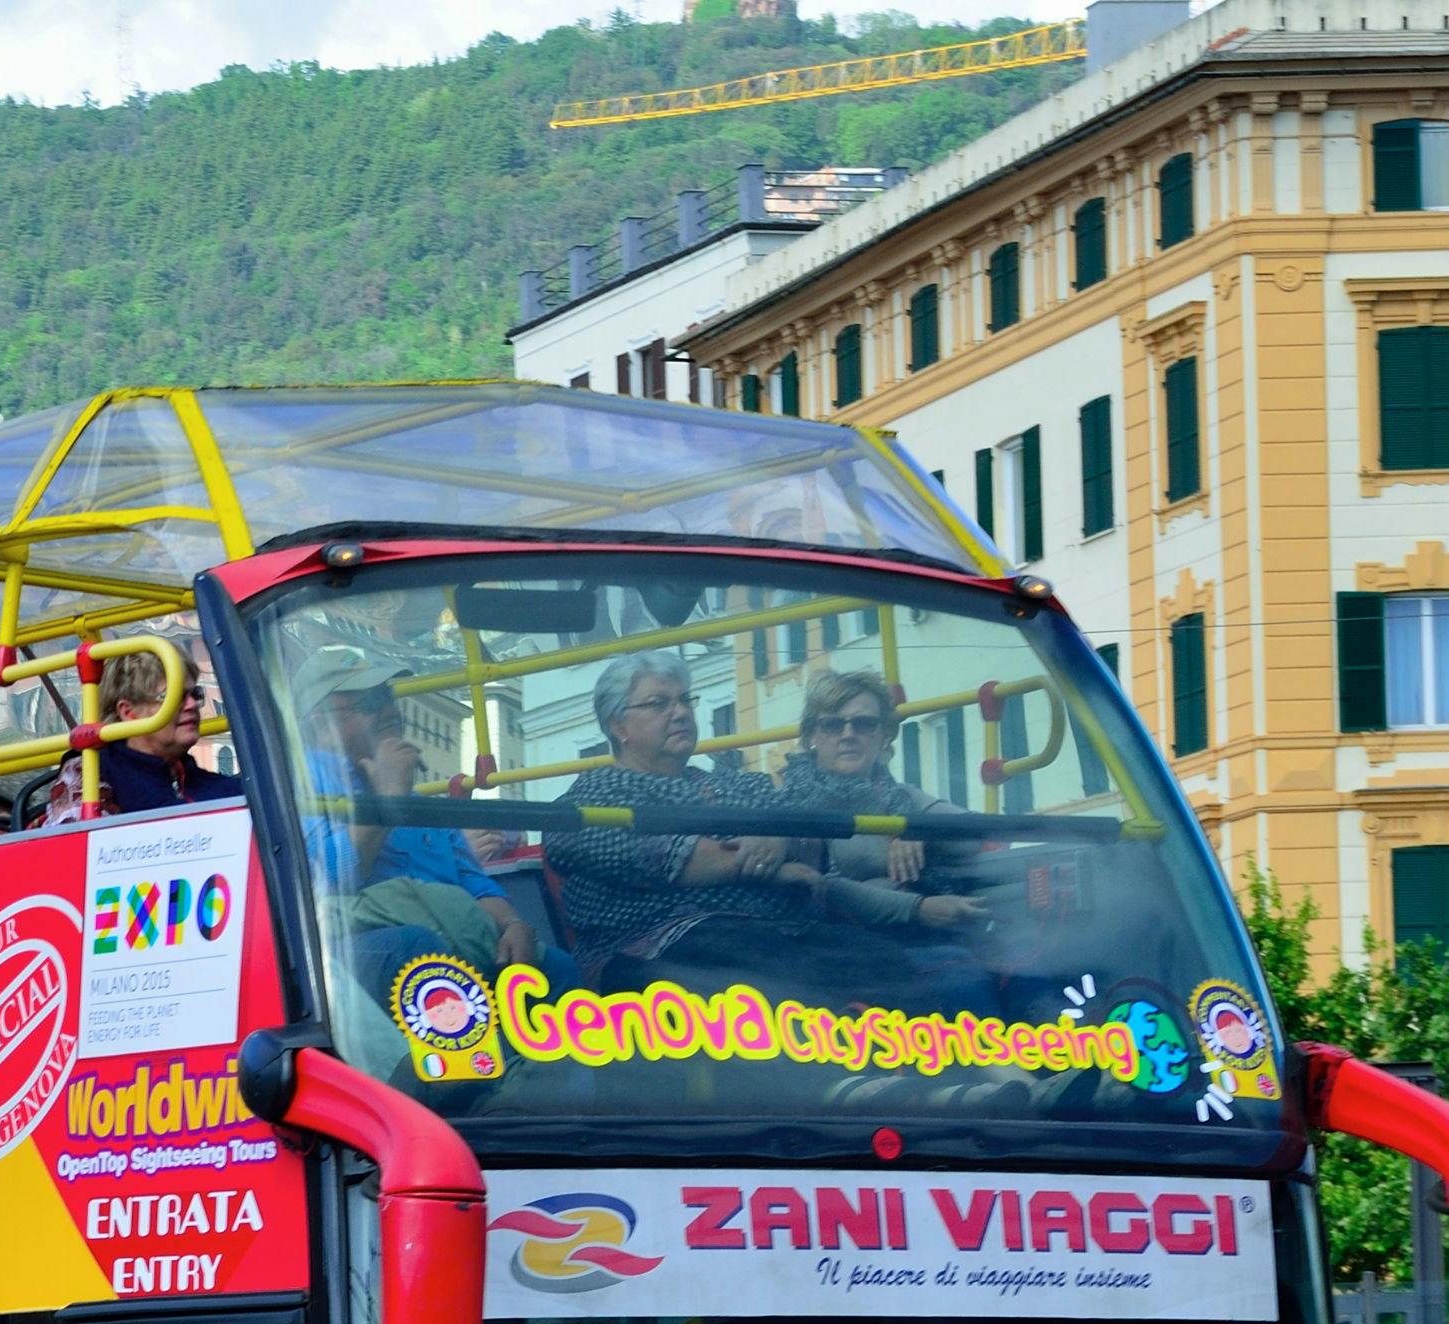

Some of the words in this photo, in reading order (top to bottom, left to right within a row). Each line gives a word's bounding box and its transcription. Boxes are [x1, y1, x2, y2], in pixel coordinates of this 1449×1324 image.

[96, 837, 162, 865] Authorised
[164, 833, 212, 855] Reseller
[93, 873, 232, 955] EXPO
[90, 973, 139, 997] MILANO
[141, 969, 172, 992] 2015
[87, 1008, 125, 1026] FEEDING
[126, 1006, 146, 1022] THE
[147, 1002, 181, 1020] PLANET
[87, 1027, 122, 1044] ENERGY
[123, 1025, 143, 1040] FOR
[143, 1022, 161, 1039] LIFE
[495, 963, 781, 1067] Genova
[68, 1058, 255, 1137] Worldwi
[57, 1151, 128, 1181] OpenTop
[130, 1141, 227, 1174] Sightseeing
[228, 1139, 277, 1163] Tours
[86, 1190, 264, 1240] ENTRATA
[681, 1186, 908, 1251] ZANI
[929, 1188, 1238, 1257] VIAGGI
[113, 1253, 223, 1294] ENTRY
[815, 1256, 841, 1286] Il
[846, 1262, 927, 1293] piacere
[934, 1261, 960, 1287] di
[966, 1265, 1069, 1297] viaggiare
[1074, 1266, 1153, 1289] insieme
